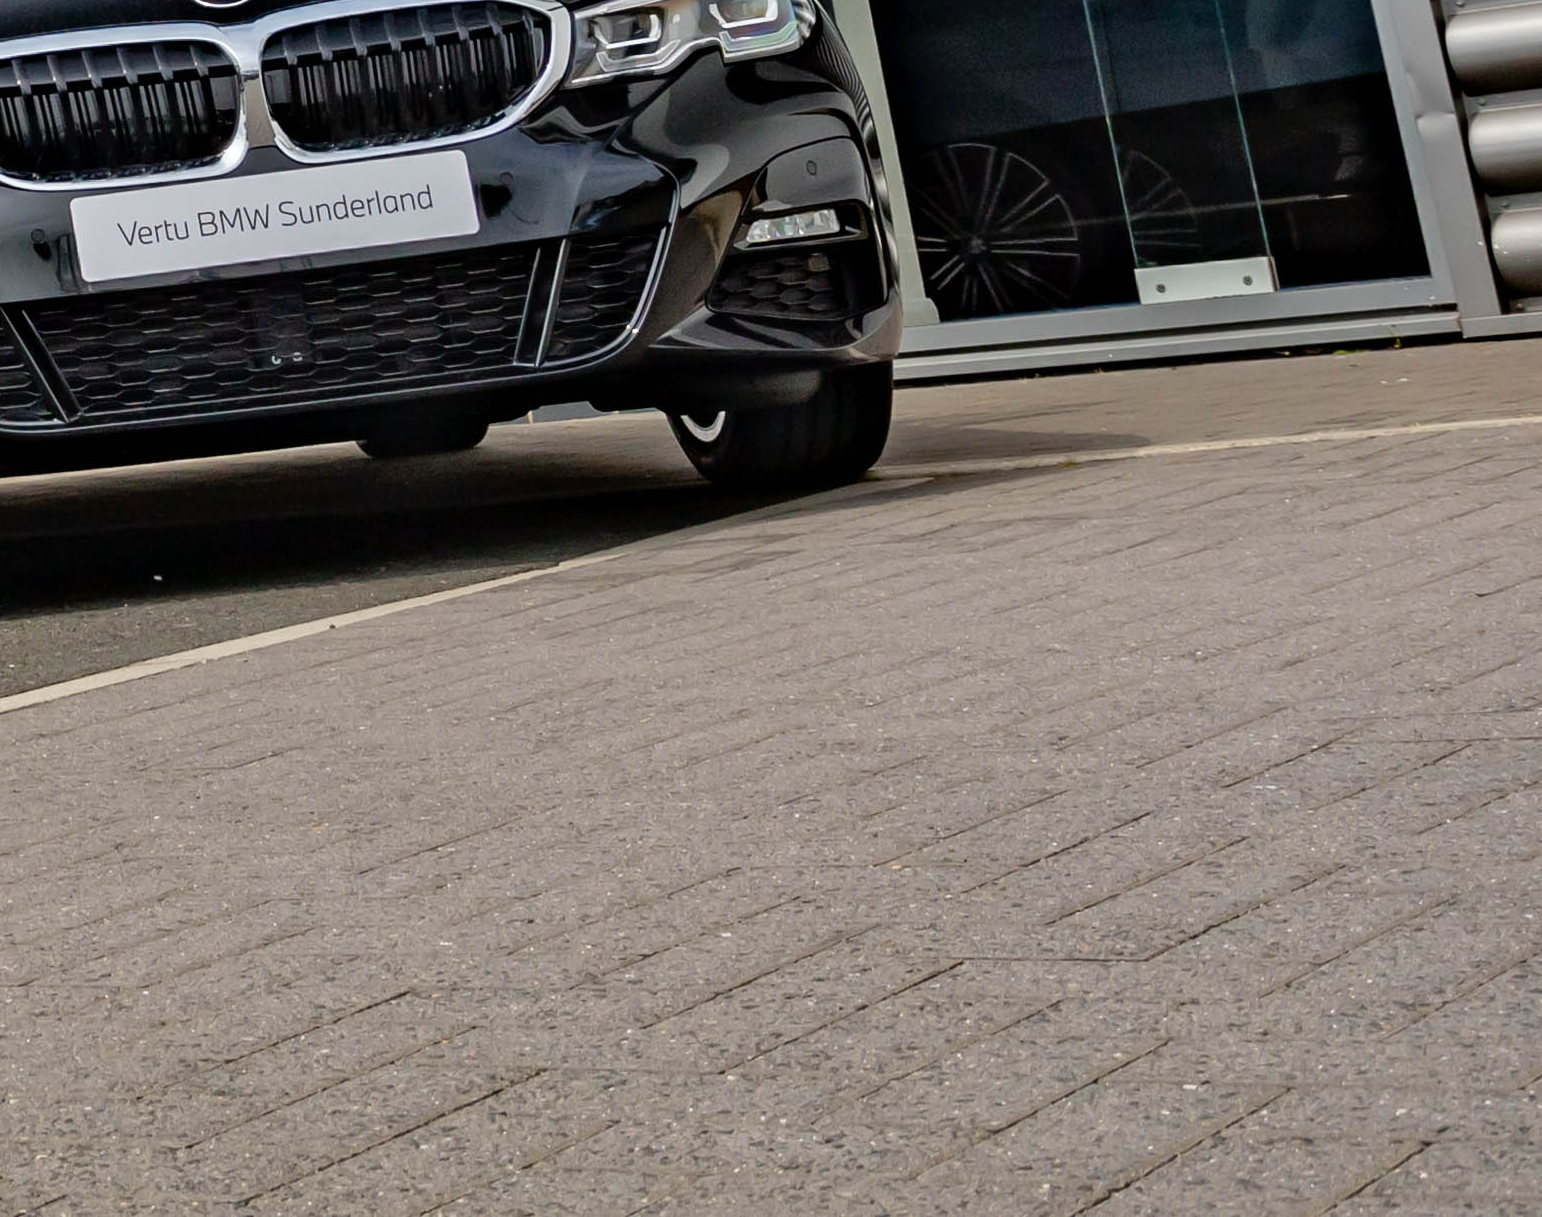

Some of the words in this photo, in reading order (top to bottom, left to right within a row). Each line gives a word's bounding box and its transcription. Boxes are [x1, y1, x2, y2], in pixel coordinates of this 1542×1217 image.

[117, 220, 189, 246] Vertu
[197, 203, 270, 237] BMW
[278, 184, 433, 227] Sunderland
